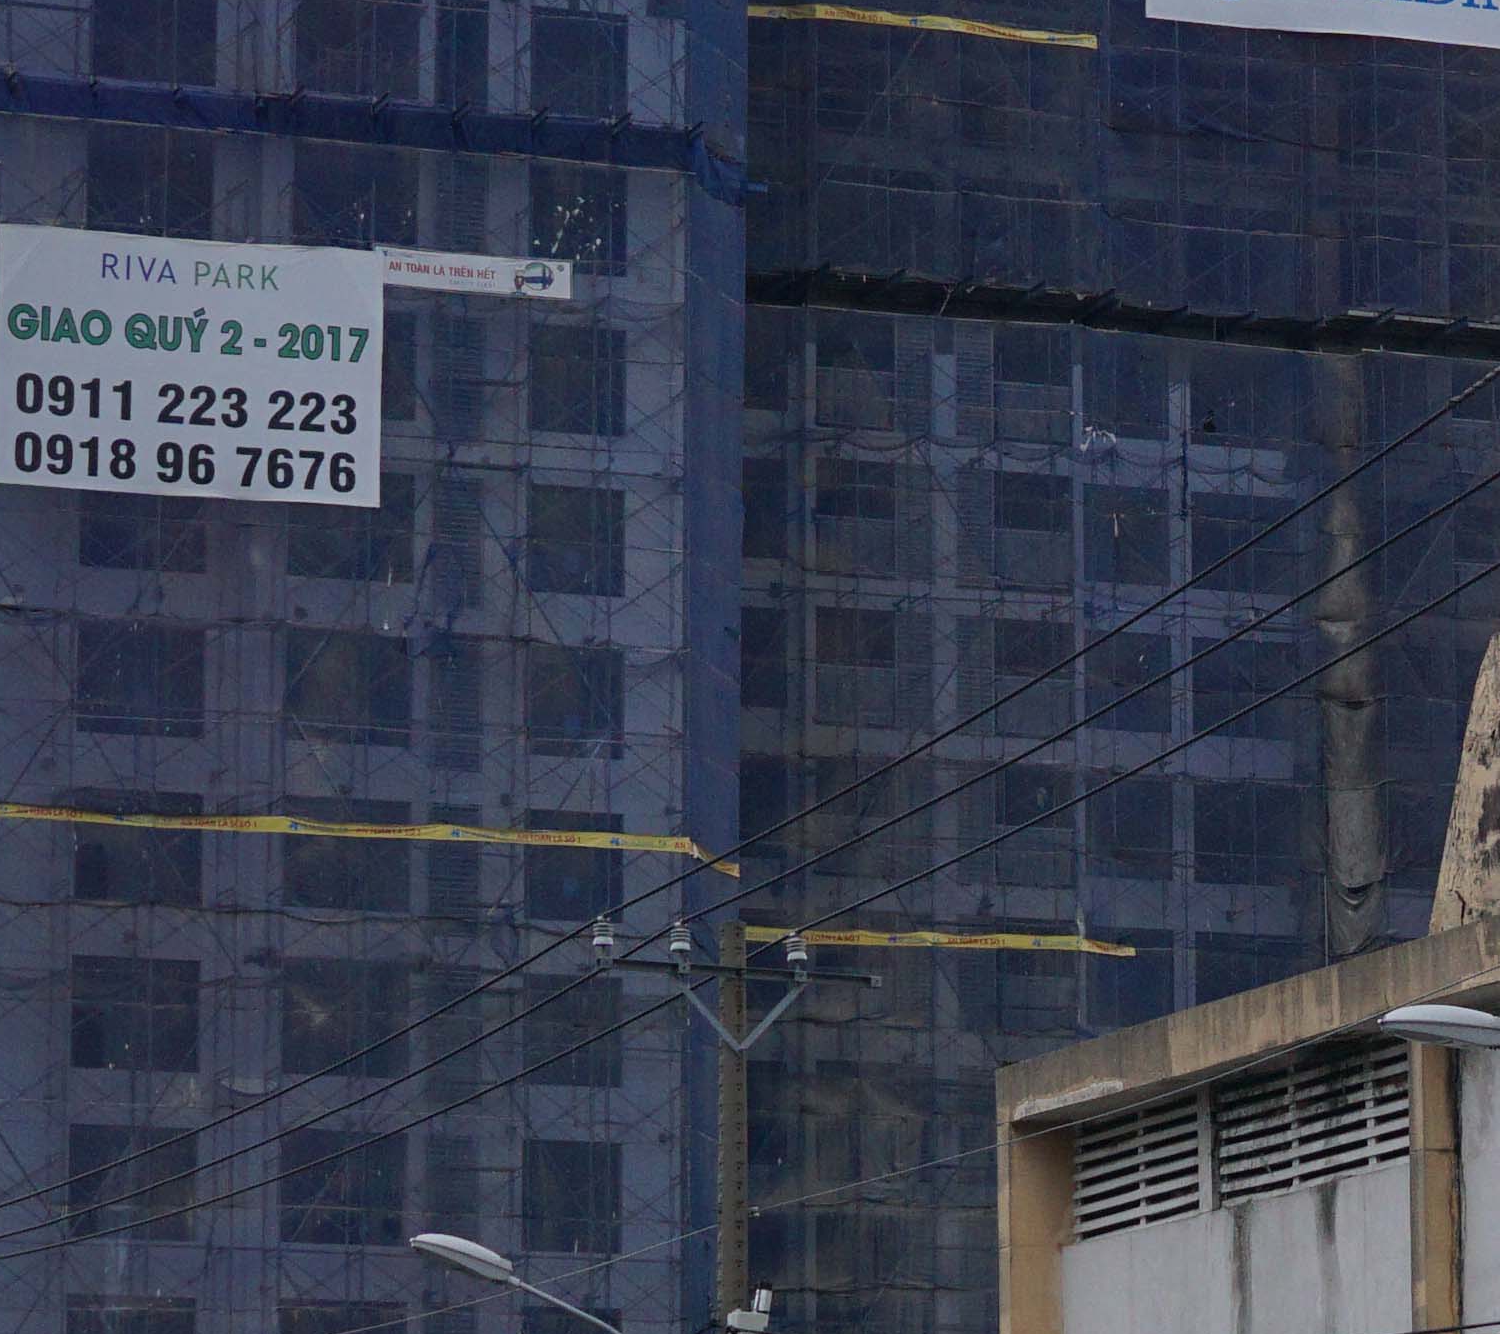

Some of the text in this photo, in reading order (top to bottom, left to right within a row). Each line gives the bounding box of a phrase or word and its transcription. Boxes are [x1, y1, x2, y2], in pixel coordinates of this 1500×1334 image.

[101, 253, 279, 291] RIVA PARK
[7, 303, 111, 346] GIAO
[125, 307, 208, 353] QUÝ
[220, 320, 243, 355] 2
[278, 323, 369, 362] 2017
[16, 373, 357, 434] 0911 223 223
[14, 431, 356, 492] 0918 96 7676
